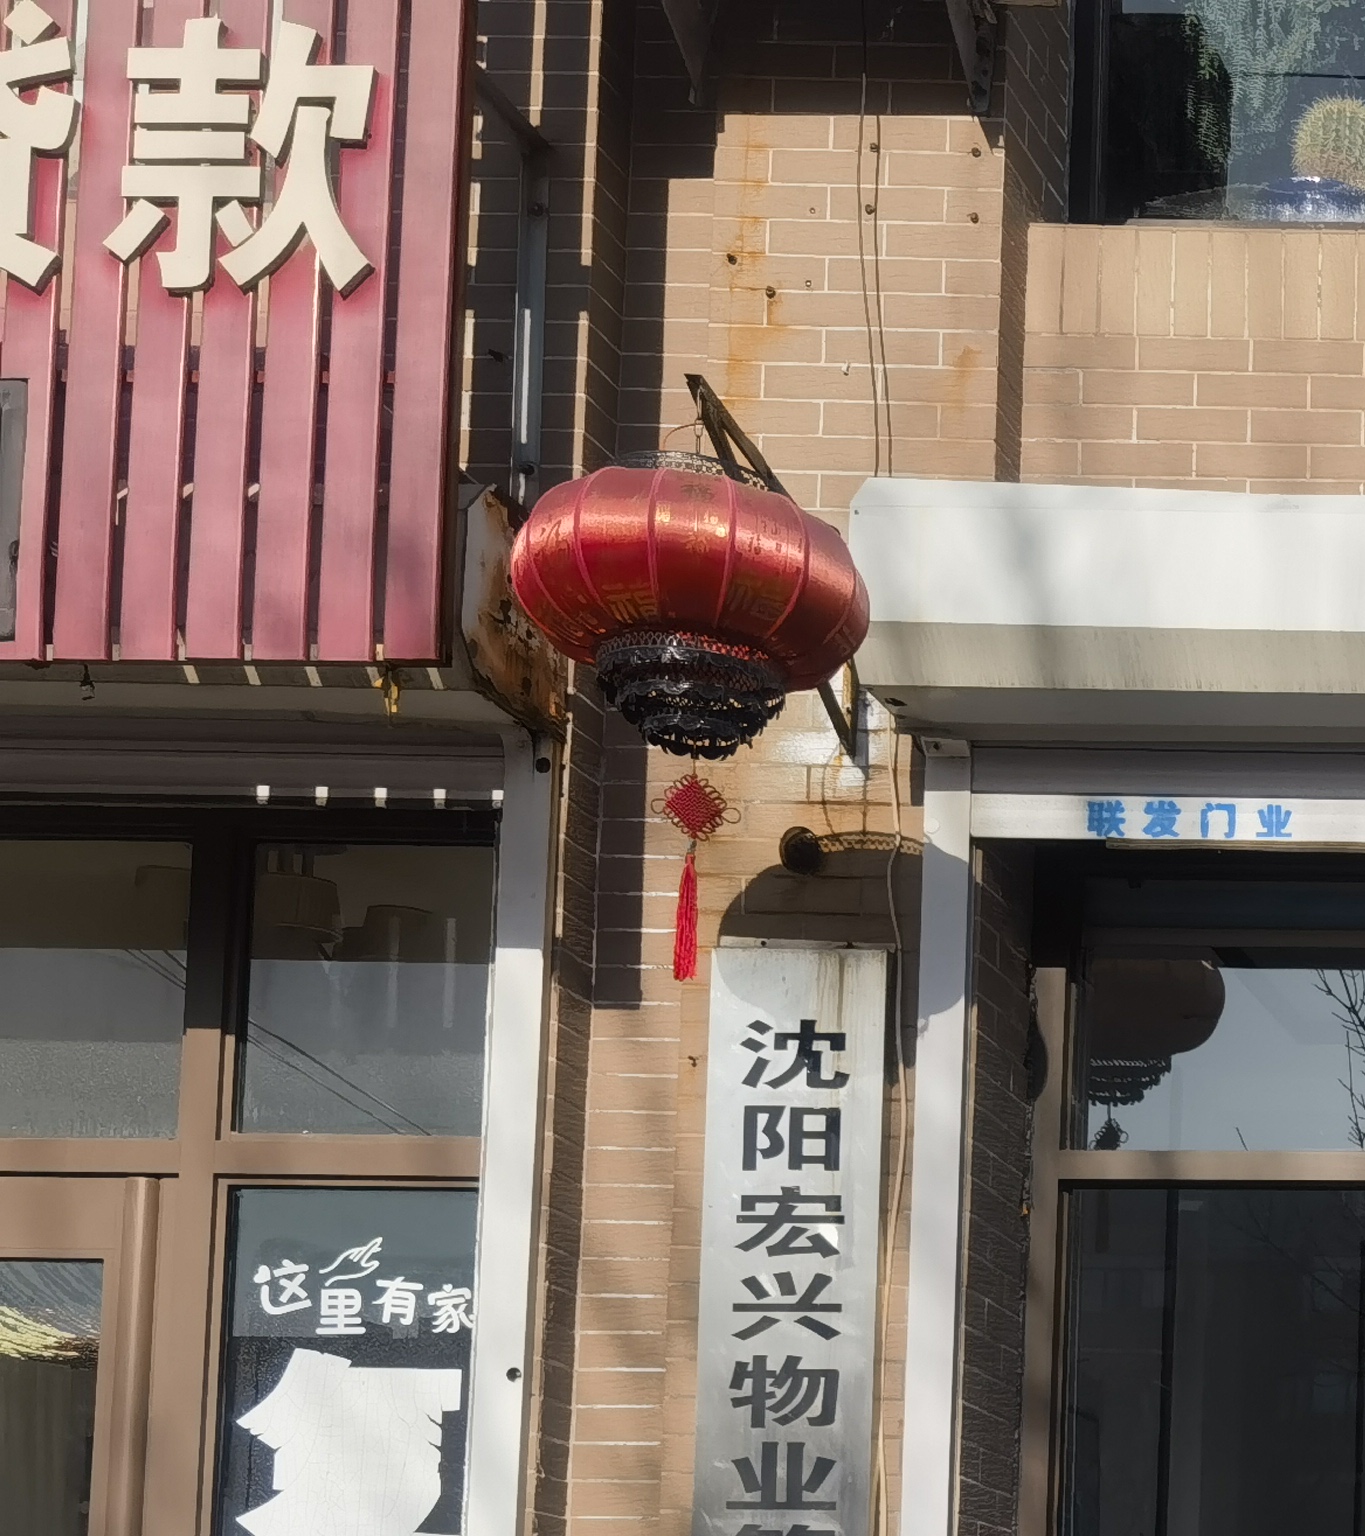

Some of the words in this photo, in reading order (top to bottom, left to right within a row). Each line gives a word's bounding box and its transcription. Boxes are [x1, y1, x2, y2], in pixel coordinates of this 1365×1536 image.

[1087, 800, 1293, 838] 联发门业
[253, 1259, 475, 1335] 这里有家
